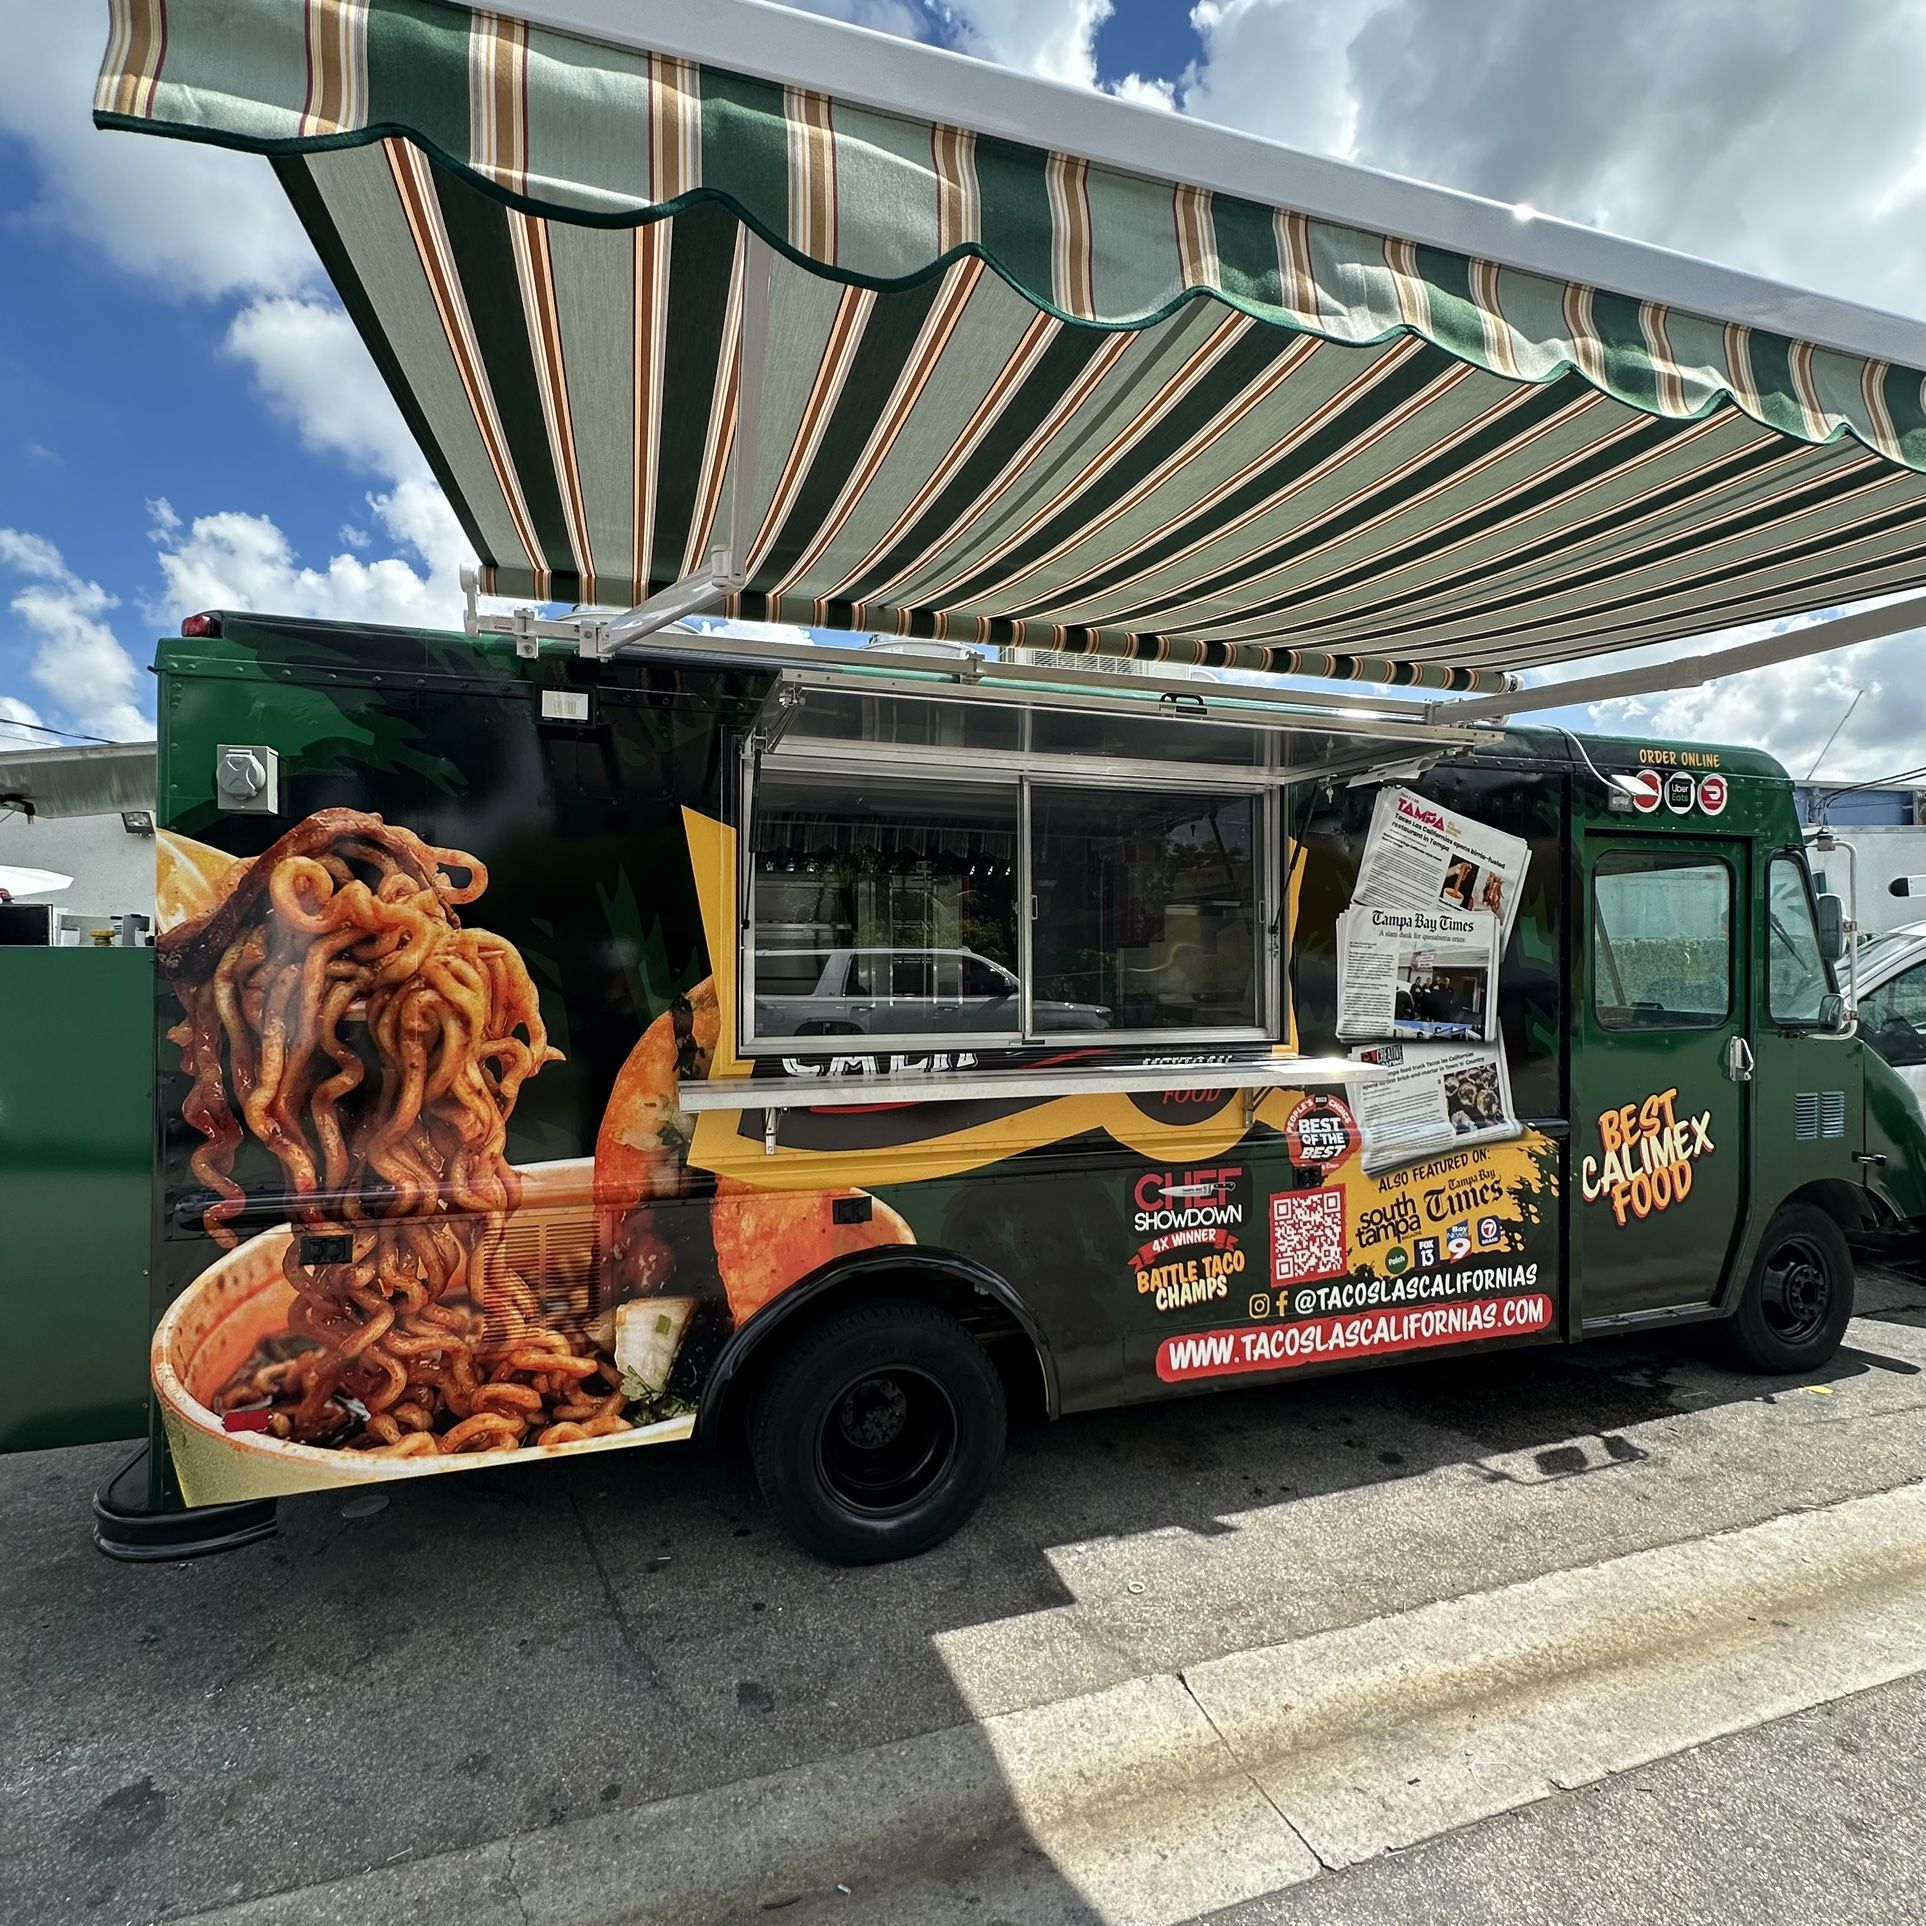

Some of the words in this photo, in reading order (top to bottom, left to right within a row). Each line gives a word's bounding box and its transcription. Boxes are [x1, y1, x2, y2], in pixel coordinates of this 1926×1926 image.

[1640, 749, 1677, 764] ORDER
[1681, 752, 1720, 768] ONLINE
[1671, 784, 1689, 793] Uber
[1671, 793, 1689, 802] Eats
[1398, 798, 1444, 831] TAMPA
[1392, 821, 1423, 839] restaurant
[1423, 834, 1429, 842] in
[1429, 838, 1450, 852] Tampa
[1395, 813, 1411, 824] Tacos
[1412, 821, 1422, 830] Las
[1422, 826, 1452, 845] Californias
[1453, 840, 1471, 853] opens
[1372, 910, 1412, 931] Tampa
[1415, 913, 1437, 932] Bay
[1440, 915, 1474, 932] Times
[1399, 931, 1412, 939] dunk
[1413, 931, 1422, 939] for
[1452, 935, 1466, 943] craze
[1377, 1045, 1402, 1063] CREATIVE
[1388, 1069, 1399, 1077] mpa
[1400, 1066, 1411, 1074] food
[1412, 1062, 1425, 1070] truck
[1425, 1059, 1440, 1067] Tacos
[1449, 1052, 1474, 1062] Californias
[1397, 1067, 1439, 1082] brick-and-mortar
[1445, 1063, 1458, 1071] Town
[1465, 1056, 1485, 1066] Country
[1162, 1088, 1221, 1105] FOOD
[1286, 1099, 1314, 1134] PEOPLE'S
[1328, 1099, 1352, 1124] CHOICE
[1298, 1117, 1341, 1133] BEST
[1598, 1088, 1677, 1152] BEST
[1301, 1133, 1318, 1145] OF
[1321, 1133, 1345, 1145] THE
[1299, 1144, 1346, 1159] BEST
[1582, 1110, 1715, 1201] CALIMEX
[1378, 1171, 1409, 1193] ALSO
[1412, 1153, 1468, 1182] FEATURED
[1472, 1148, 1491, 1163] ON:
[1448, 1174, 1478, 1191] Tampa
[1478, 1169, 1497, 1182] Bay
[1134, 1167, 1242, 1211] CHEF
[1424, 1174, 1504, 1222] Times
[1611, 1160, 1692, 1226] FOOD
[1134, 1204, 1242, 1231] SHOWDOWN
[1359, 1191, 1417, 1230] south
[1152, 1236, 1170, 1252] 4X
[1171, 1228, 1217, 1247] WINNER
[1355, 1214, 1422, 1249] tampa
[1447, 1231, 1468, 1239] NEWS
[1452, 1225, 1468, 1233] Bay
[1483, 1223, 1494, 1235] 7
[1419, 1239, 1434, 1249] FOX
[1448, 1237, 1471, 1260] 9
[1388, 1254, 1406, 1266] Patch
[1420, 1249, 1435, 1267] 13
[1136, 1260, 1199, 1294] BATTLE
[1201, 1250, 1246, 1278] TACO
[1155, 1274, 1229, 1312] CHAMPS
[1294, 1263, 1538, 1314] @TACOSLASCALIFORNIAS
[1169, 1298, 1544, 1371] WWW.TACOSLASCALIFORNIAS.COM
